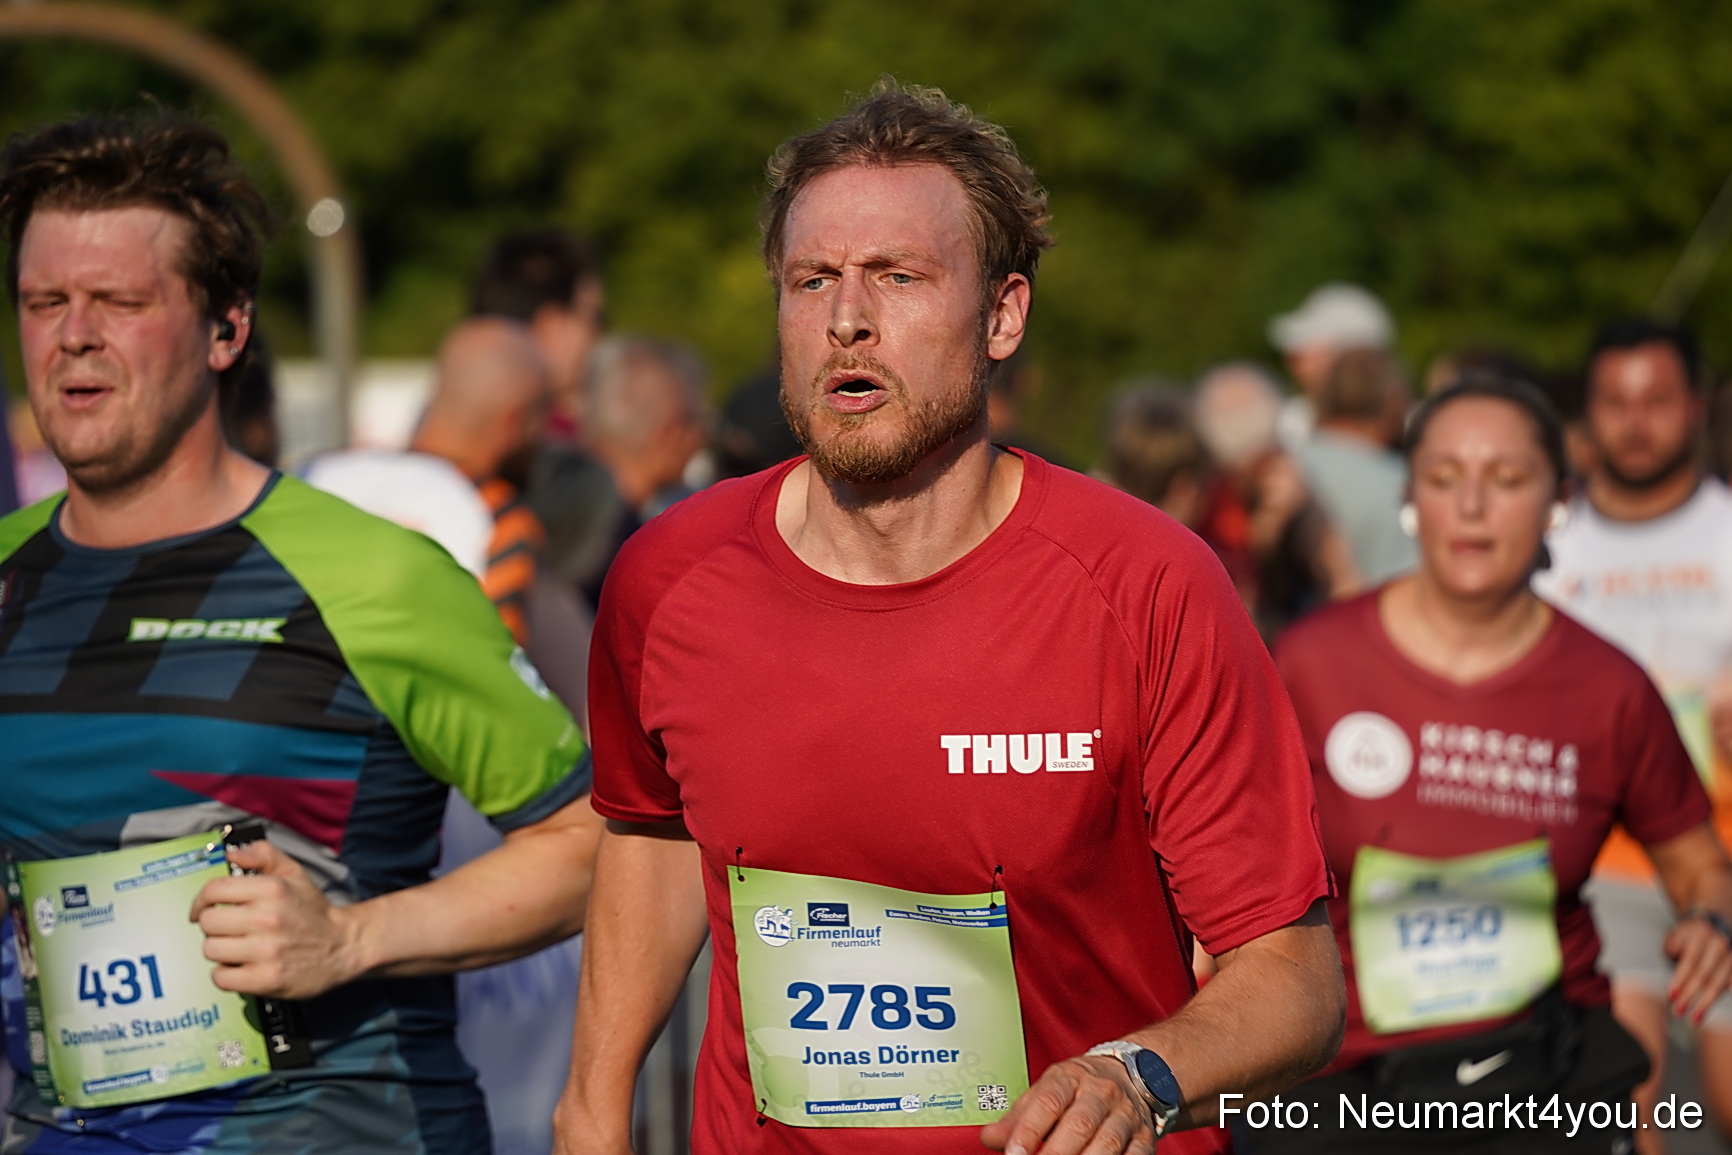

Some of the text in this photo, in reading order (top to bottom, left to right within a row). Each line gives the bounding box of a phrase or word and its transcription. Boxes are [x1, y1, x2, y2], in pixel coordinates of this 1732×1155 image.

[940, 733, 1094, 774] THULE
[1052, 760, 1089, 769] SWEDEN
[817, 911, 848, 920] Fischer
[797, 925, 882, 940] Firmenlauf
[1396, 906, 1504, 949] 1250
[831, 938, 882, 948] neumarkt
[77, 954, 165, 1008] 431
[787, 982, 956, 1031] 2785
[60, 1016, 128, 1047] Dominik
[131, 1003, 221, 1039] Staudigl
[801, 1045, 960, 1065] Jonas Dörner
[859, 1071, 905, 1079] Thule GmbH
[810, 1102, 897, 1113] firmenlauf.bayern
[922, 1098, 964, 1109] Firmenlauf
